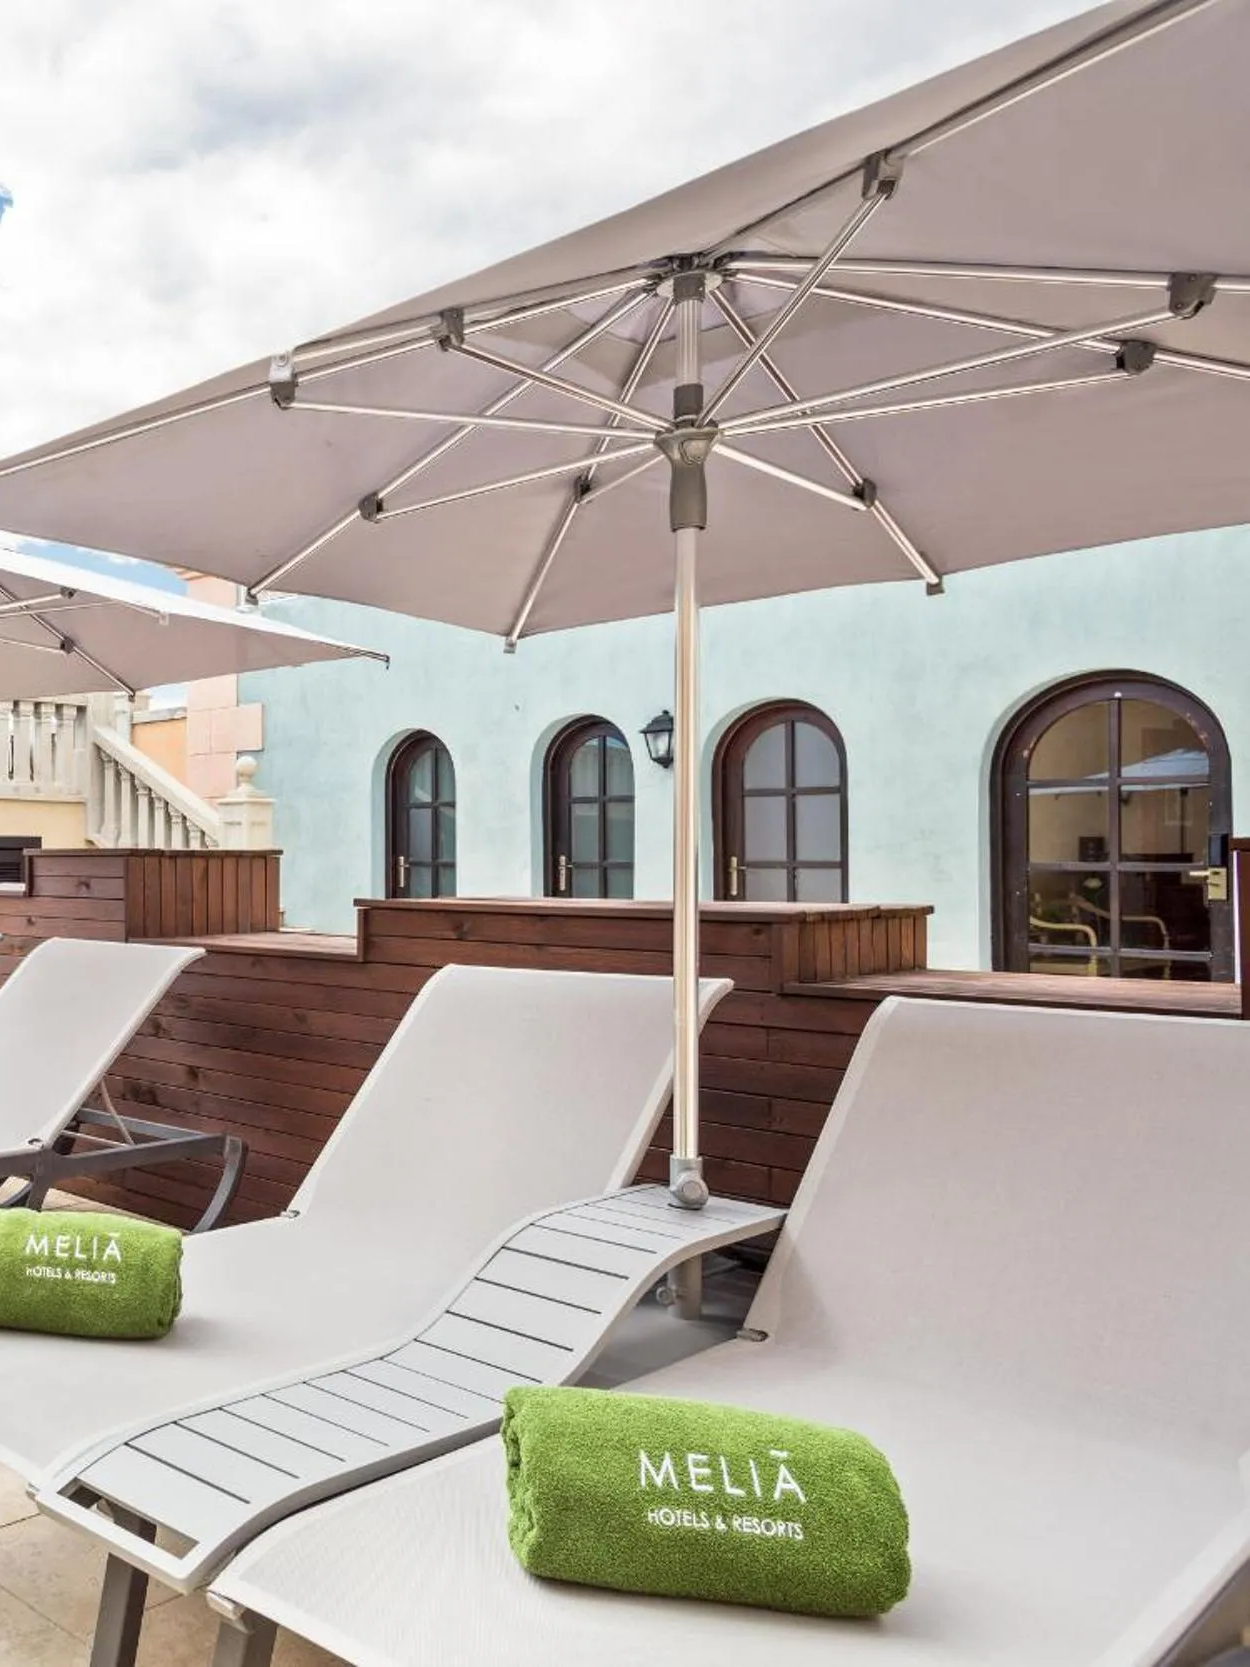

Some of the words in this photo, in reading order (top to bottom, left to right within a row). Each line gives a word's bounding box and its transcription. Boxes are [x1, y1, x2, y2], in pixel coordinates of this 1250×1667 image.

[26, 1265, 63, 1280] HOTELS
[64, 1268, 73, 1281] &
[75, 1269, 117, 1285] RESORTS
[648, 1507, 711, 1530] HOTELS
[714, 1514, 728, 1532] &
[732, 1514, 804, 1540] RESORTS
